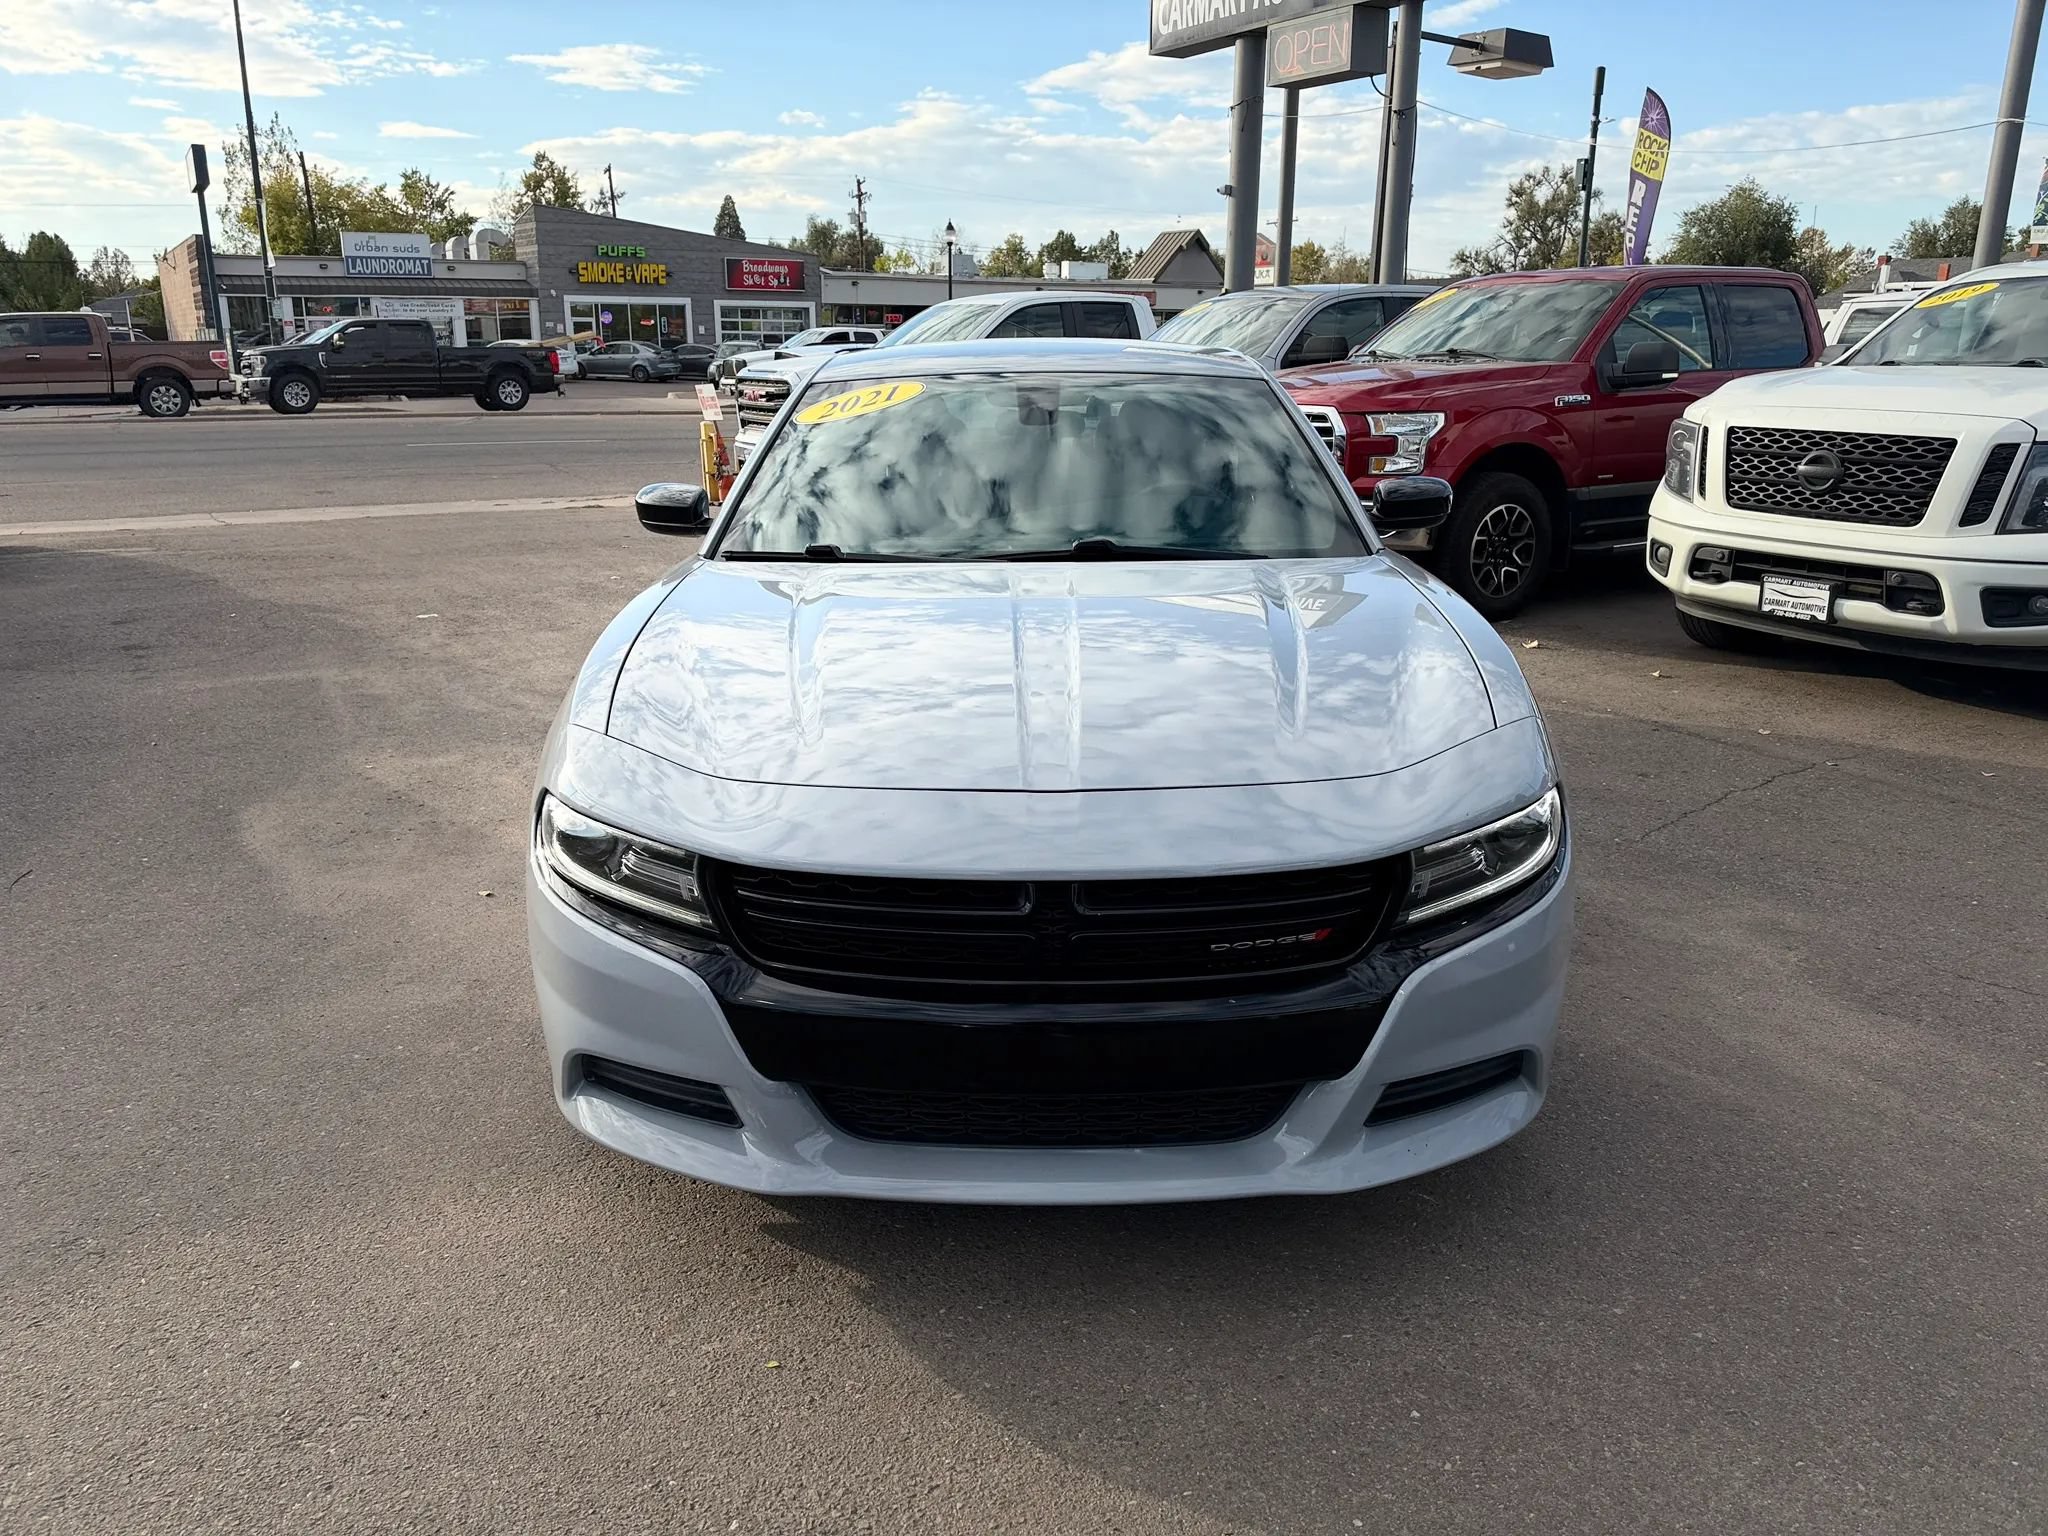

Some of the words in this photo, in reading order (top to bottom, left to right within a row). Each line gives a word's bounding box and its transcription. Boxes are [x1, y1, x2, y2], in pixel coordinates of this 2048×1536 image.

[1274, 18, 1350, 73] OPEN
[1637, 131, 1668, 159] ROCK
[1633, 151, 1661, 175] CHIP
[1626, 179, 1646, 265] REP
[354, 240, 389, 253] urban
[392, 243, 421, 254] suds
[597, 244, 647, 257] PUFFS
[348, 257, 429, 275] LAUNDROMAT
[577, 261, 625, 283] SMOKE
[625, 266, 633, 280] &
[632, 263, 667, 285] VAPE
[741, 260, 789, 274] Broadways
[816, 384, 901, 420] 2021
[1764, 576, 1792, 585] CARMART
[1793, 580, 1830, 590] AUTOMOTIVE
[1764, 597, 1790, 609] CARMART
[1790, 601, 1827, 614] AUTOMOTIVE
[1210, 931, 1317, 951] DODGE
